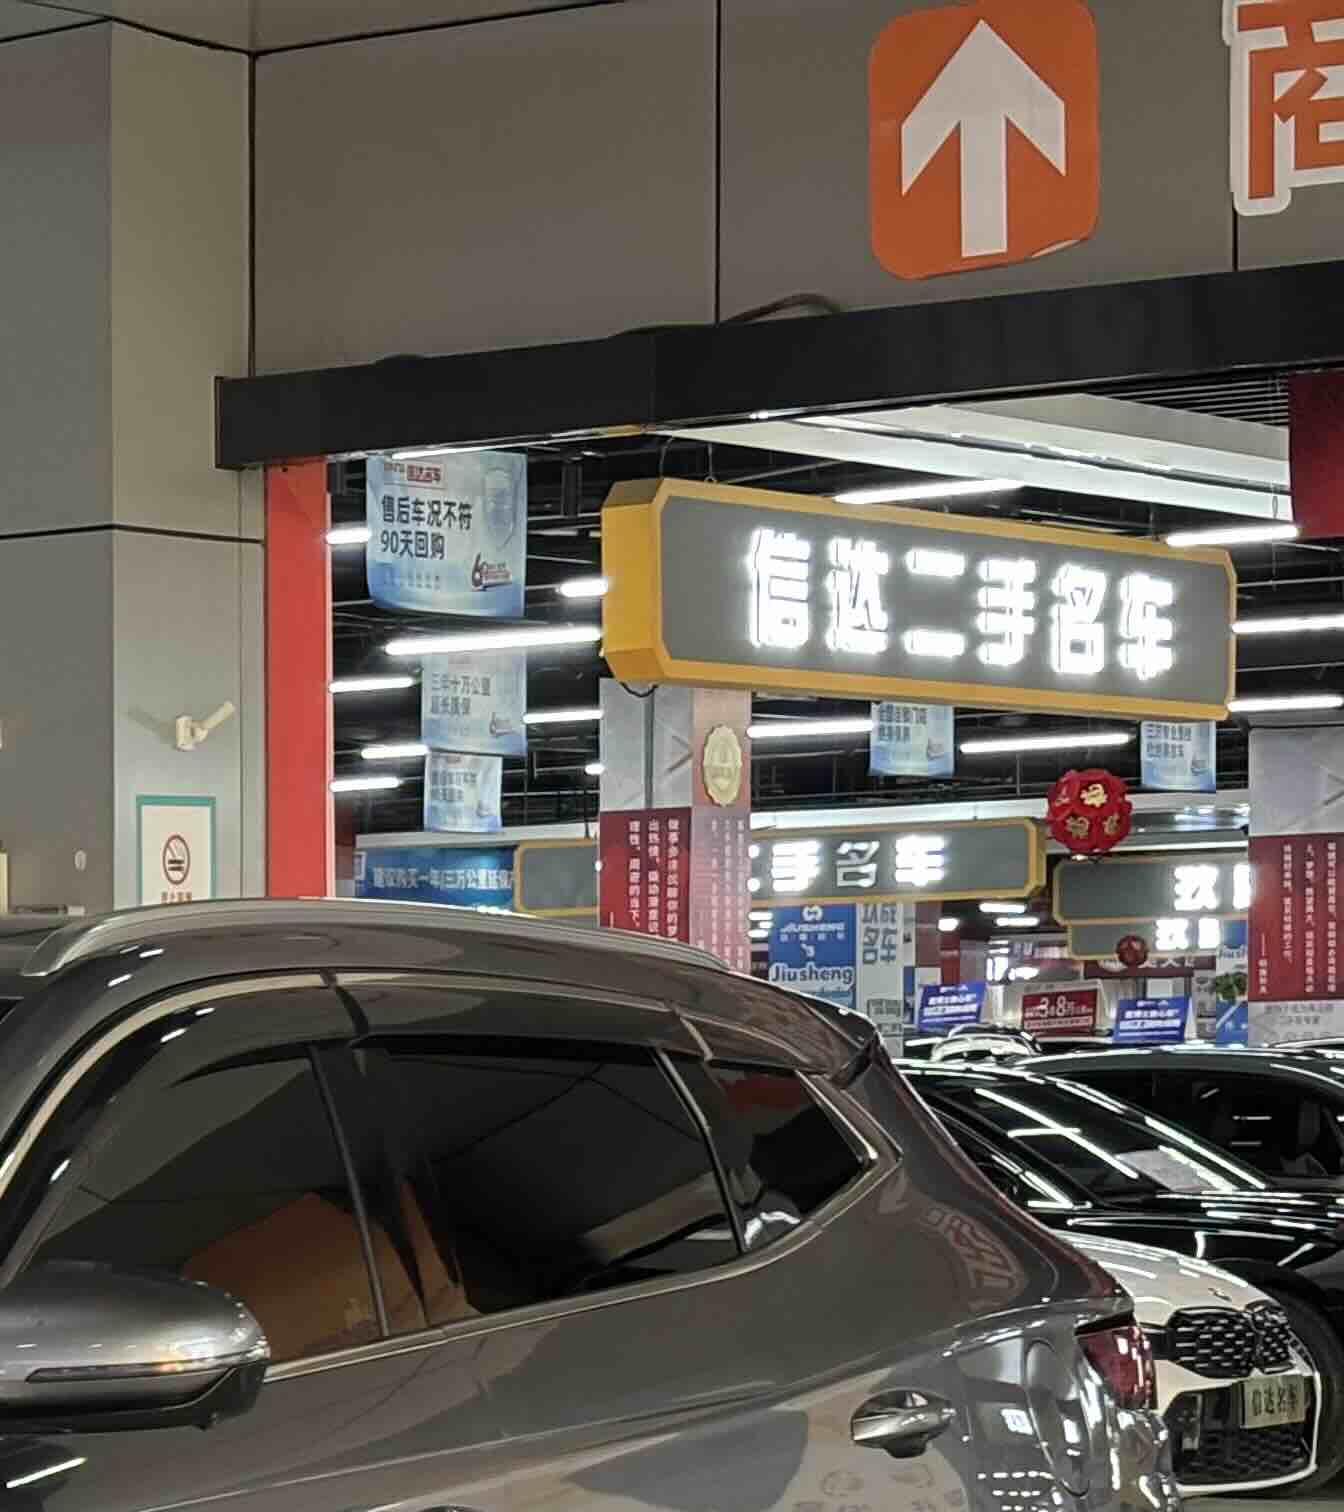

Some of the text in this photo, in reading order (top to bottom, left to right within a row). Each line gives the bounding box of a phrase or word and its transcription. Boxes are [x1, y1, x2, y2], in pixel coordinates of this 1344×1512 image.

[382, 495, 472, 530] 售后车况不符
[380, 530, 445, 560] 90天回购
[746, 527, 1175, 681] 信达二手名车
[747, 834, 946, 894] 手名车
